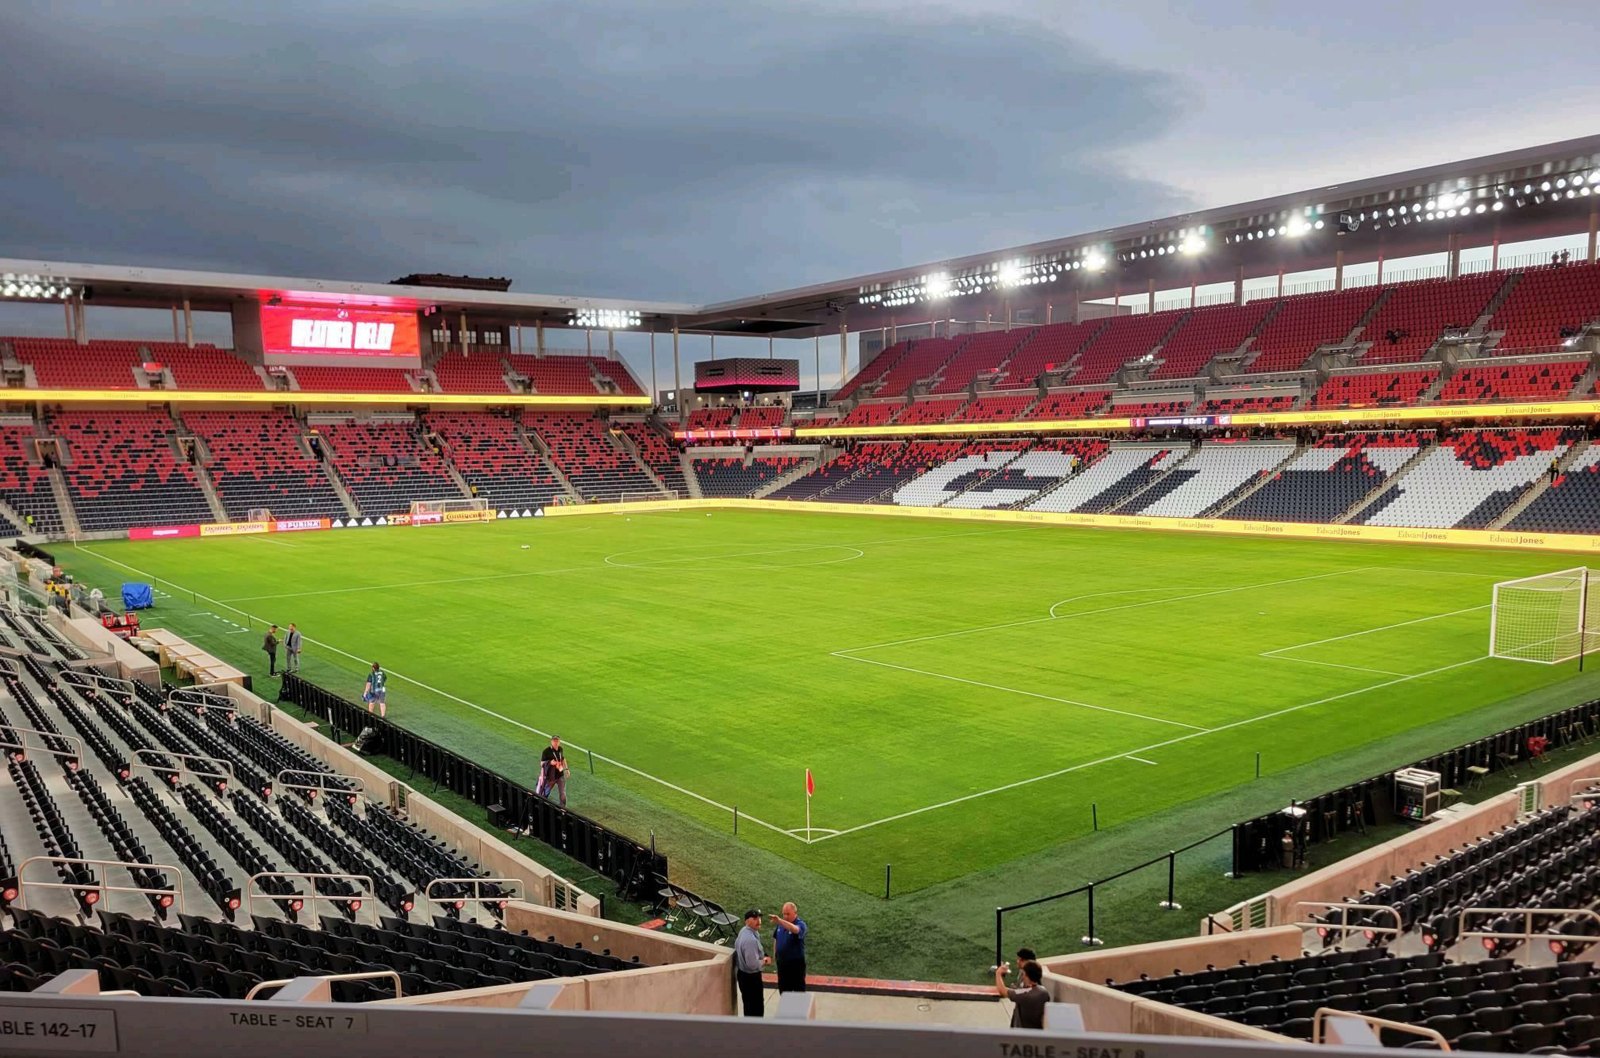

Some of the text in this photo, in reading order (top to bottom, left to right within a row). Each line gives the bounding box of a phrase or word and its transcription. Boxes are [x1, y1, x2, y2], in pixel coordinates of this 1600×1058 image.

[229, 1012, 278, 1026] TABLE
[295, 1015, 334, 1029] SEAT
[344, 1017, 354, 1029] 7
[40, 1022, 96, 1038] 142-17
[999, 1043, 1055, 1058] TABLE
[1076, 1047, 1122, 1058] SEAT
